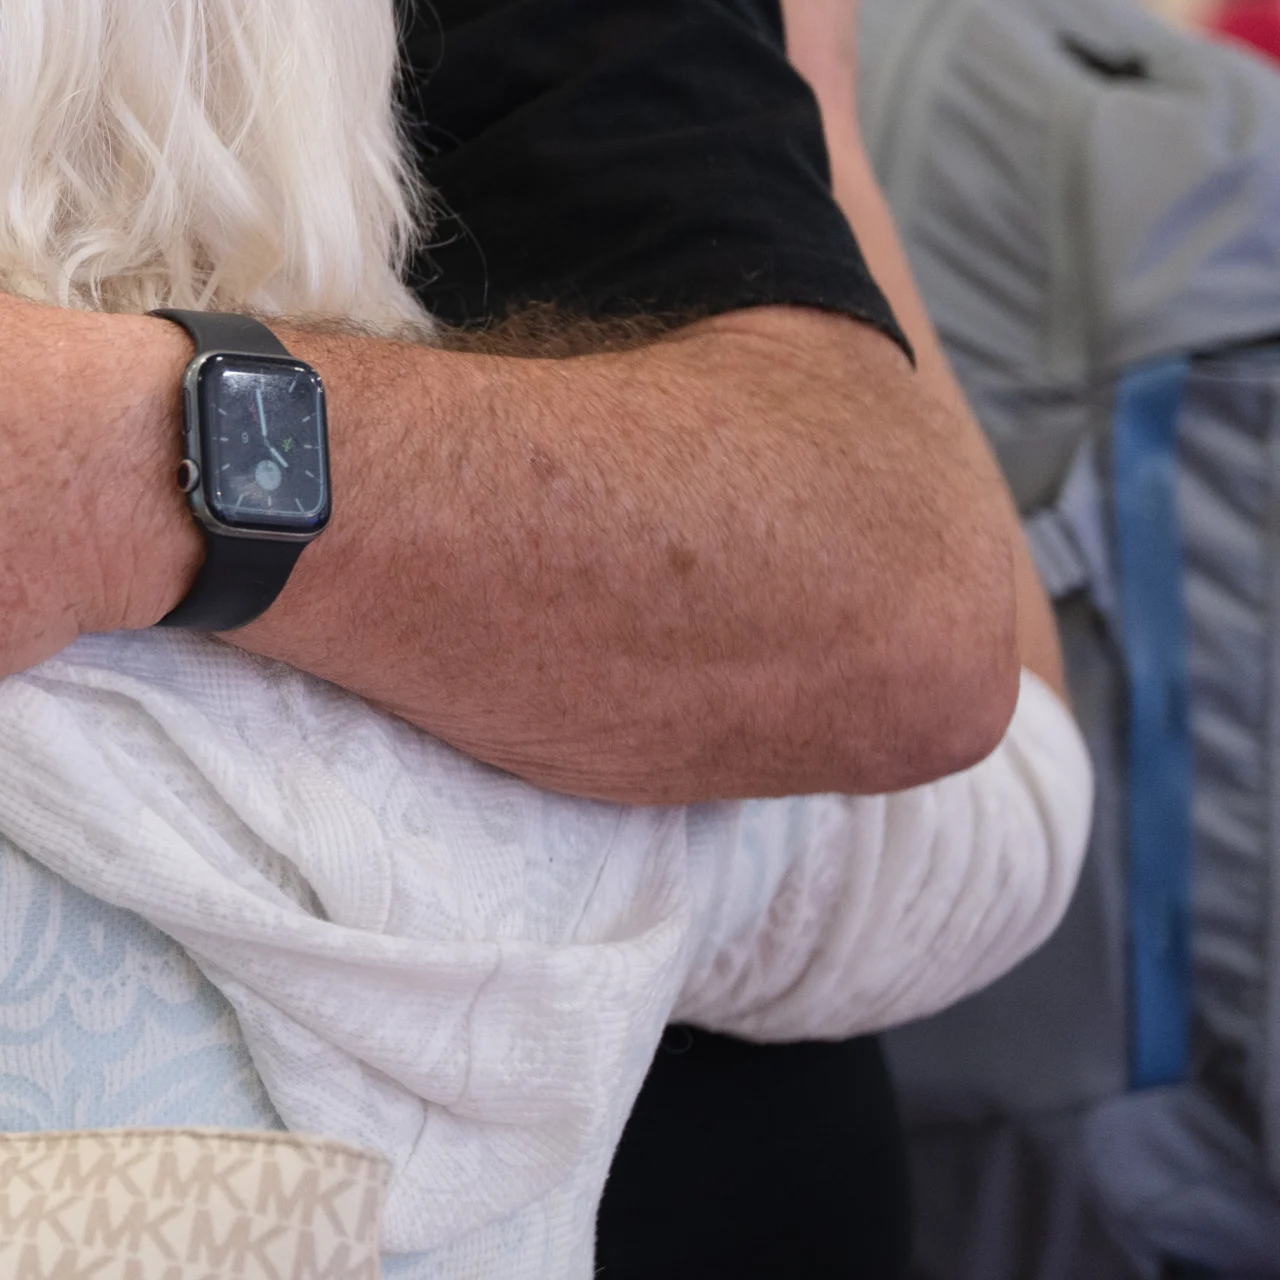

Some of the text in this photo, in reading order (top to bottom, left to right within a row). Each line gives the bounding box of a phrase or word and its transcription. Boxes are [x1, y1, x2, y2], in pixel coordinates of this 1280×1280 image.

[53, 1152, 151, 1197] MK
[152, 1152, 253, 1209] MK
[256, 1162, 358, 1236] MK
[84, 1197, 185, 1260] MK
[187, 1209, 291, 1280] MK
